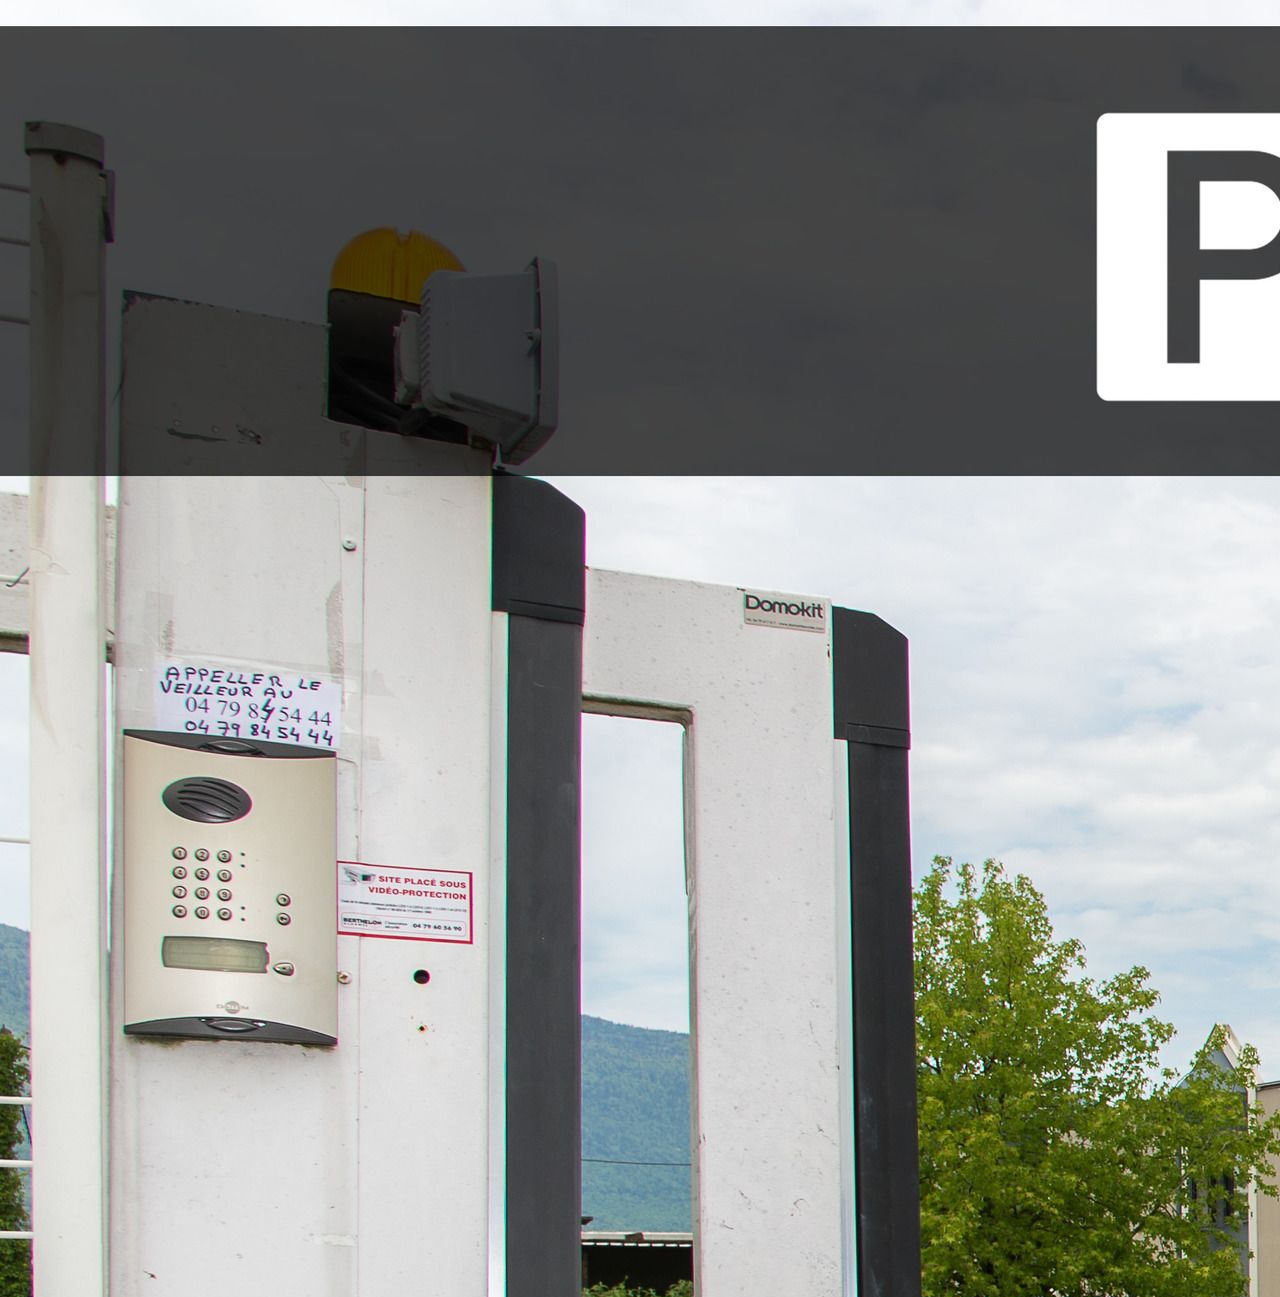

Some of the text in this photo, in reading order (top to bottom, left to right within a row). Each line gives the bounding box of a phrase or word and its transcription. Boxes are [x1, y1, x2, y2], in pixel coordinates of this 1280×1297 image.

[745, 594, 823, 619] Domokit
[160, 680, 293, 699] VEILLEUR AU
[165, 666, 322, 691] APPELLER LE
[185, 697, 210, 713] 04
[218, 699, 240, 716] 79
[279, 706, 302, 723] 54
[308, 710, 332, 726] 44
[185, 720, 333, 746] 04 79 84 54 44
[368, 885, 467, 900] VIDÉO-PROTECTION
[378, 875, 467, 889] SITE PLACÉ SOUS
